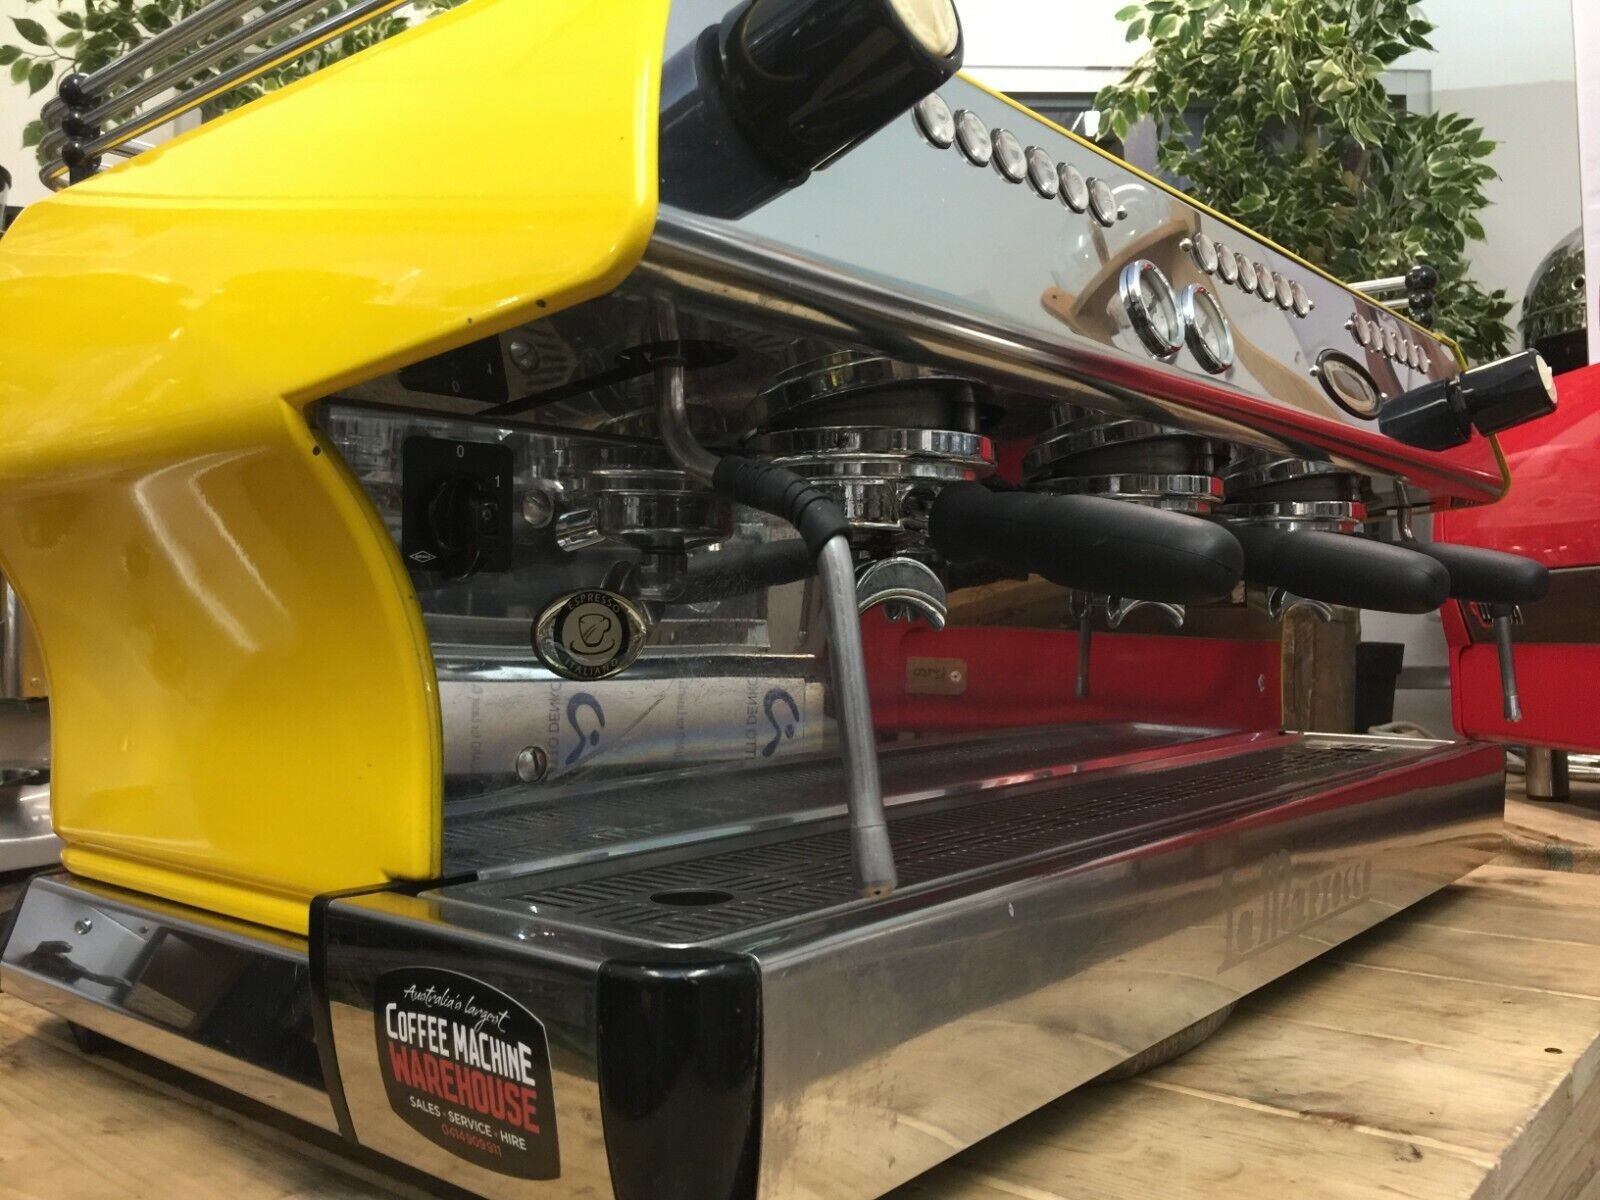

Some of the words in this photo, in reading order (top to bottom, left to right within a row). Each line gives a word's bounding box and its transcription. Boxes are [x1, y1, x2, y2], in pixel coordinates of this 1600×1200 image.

[456, 445, 465, 458] 0
[494, 475, 501, 488] 1
[567, 593, 621, 613] ESPRESSO
[564, 659, 619, 677] ITALIANO
[403, 984, 462, 1011] Australia's
[464, 995, 511, 1034] largest
[386, 1003, 450, 1058] COFFEE
[452, 1022, 536, 1087] MACHINE
[389, 1041, 540, 1134] WAREHOUSE
[409, 1096, 442, 1117] SALES
[447, 1111, 493, 1138] SERVICE
[499, 1130, 527, 1151] HIRE
